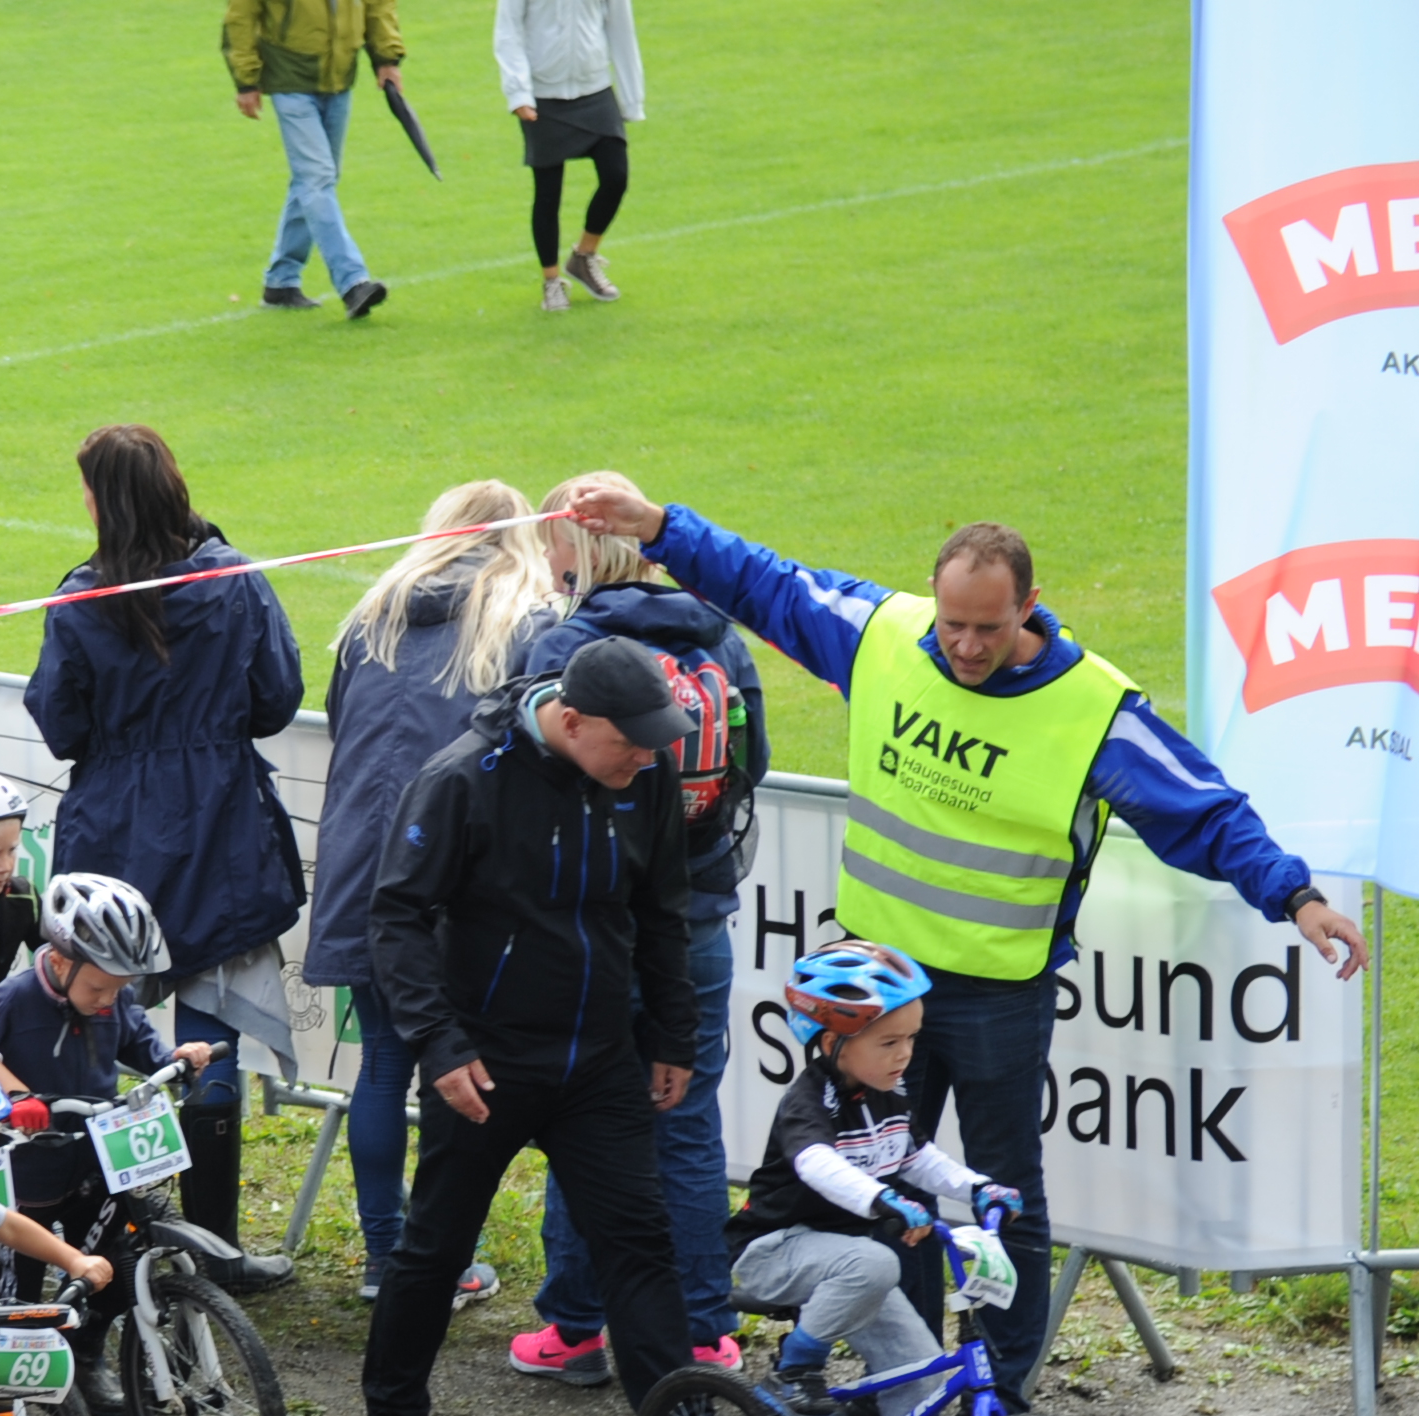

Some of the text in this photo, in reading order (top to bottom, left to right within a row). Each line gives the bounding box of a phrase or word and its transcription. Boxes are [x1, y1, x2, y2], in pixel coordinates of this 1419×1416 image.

[892, 701, 1010, 779] VAKT
[902, 756, 993, 804] Haugesund
[129, 1120, 169, 1163] 62
[79, 1197, 118, 1255] BS
[8, 1352, 51, 1386] 69
